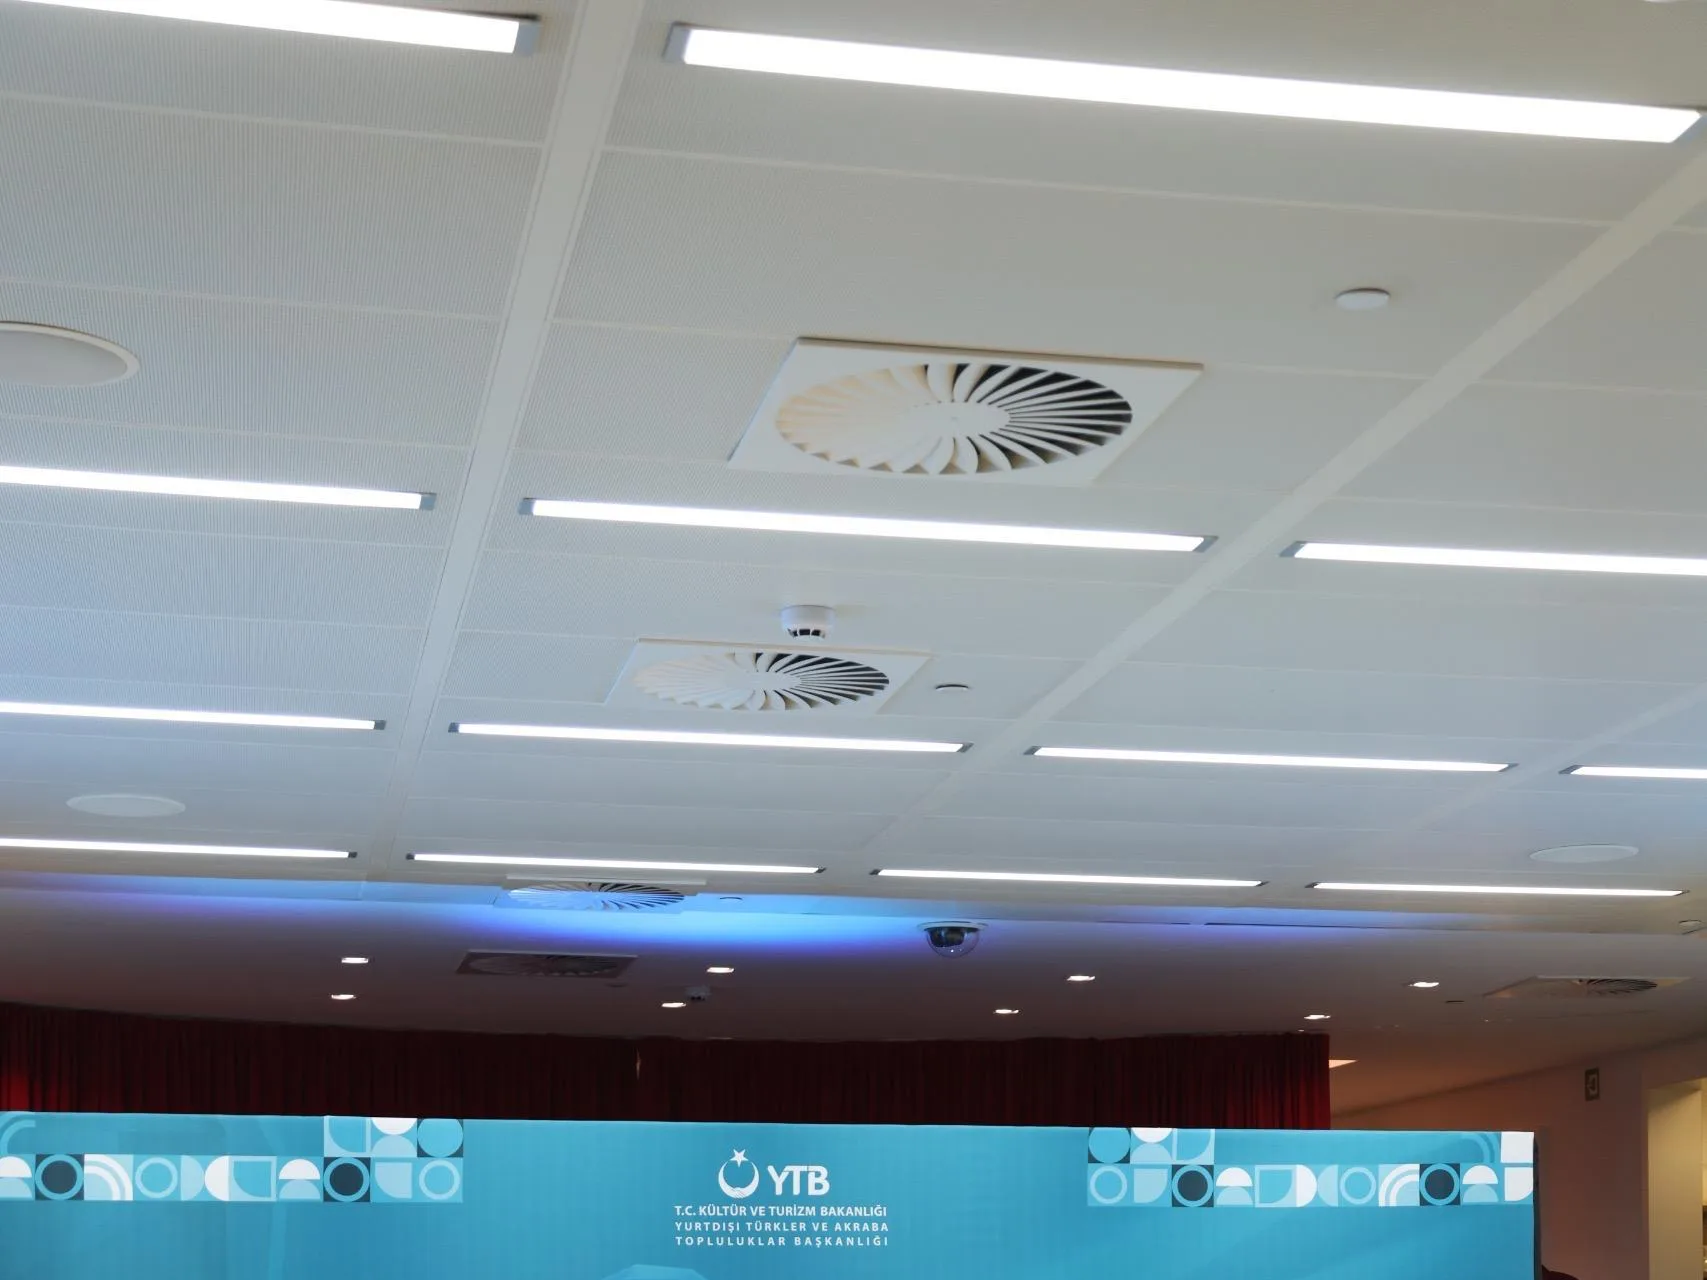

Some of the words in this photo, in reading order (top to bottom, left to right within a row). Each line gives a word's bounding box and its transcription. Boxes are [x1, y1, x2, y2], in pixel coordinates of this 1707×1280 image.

[767, 1165, 830, 1196] YTB
[674, 1205, 696, 1216] T.C.
[699, 1203, 747, 1217] KÜLTÜR
[750, 1205, 766, 1217] VE
[769, 1203, 816, 1217] TURİZM
[820, 1203, 887, 1217] BAKANLIĞI
[675, 1221, 741, 1234] YURTDIŞI
[746, 1219, 807, 1232] TÜRKLER
[812, 1221, 829, 1232] VE
[834, 1221, 889, 1232] AKRABA
[675, 1236, 786, 1246] TOPLULUKLAR
[794, 1234, 889, 1248] BAŞKANLIĞI
